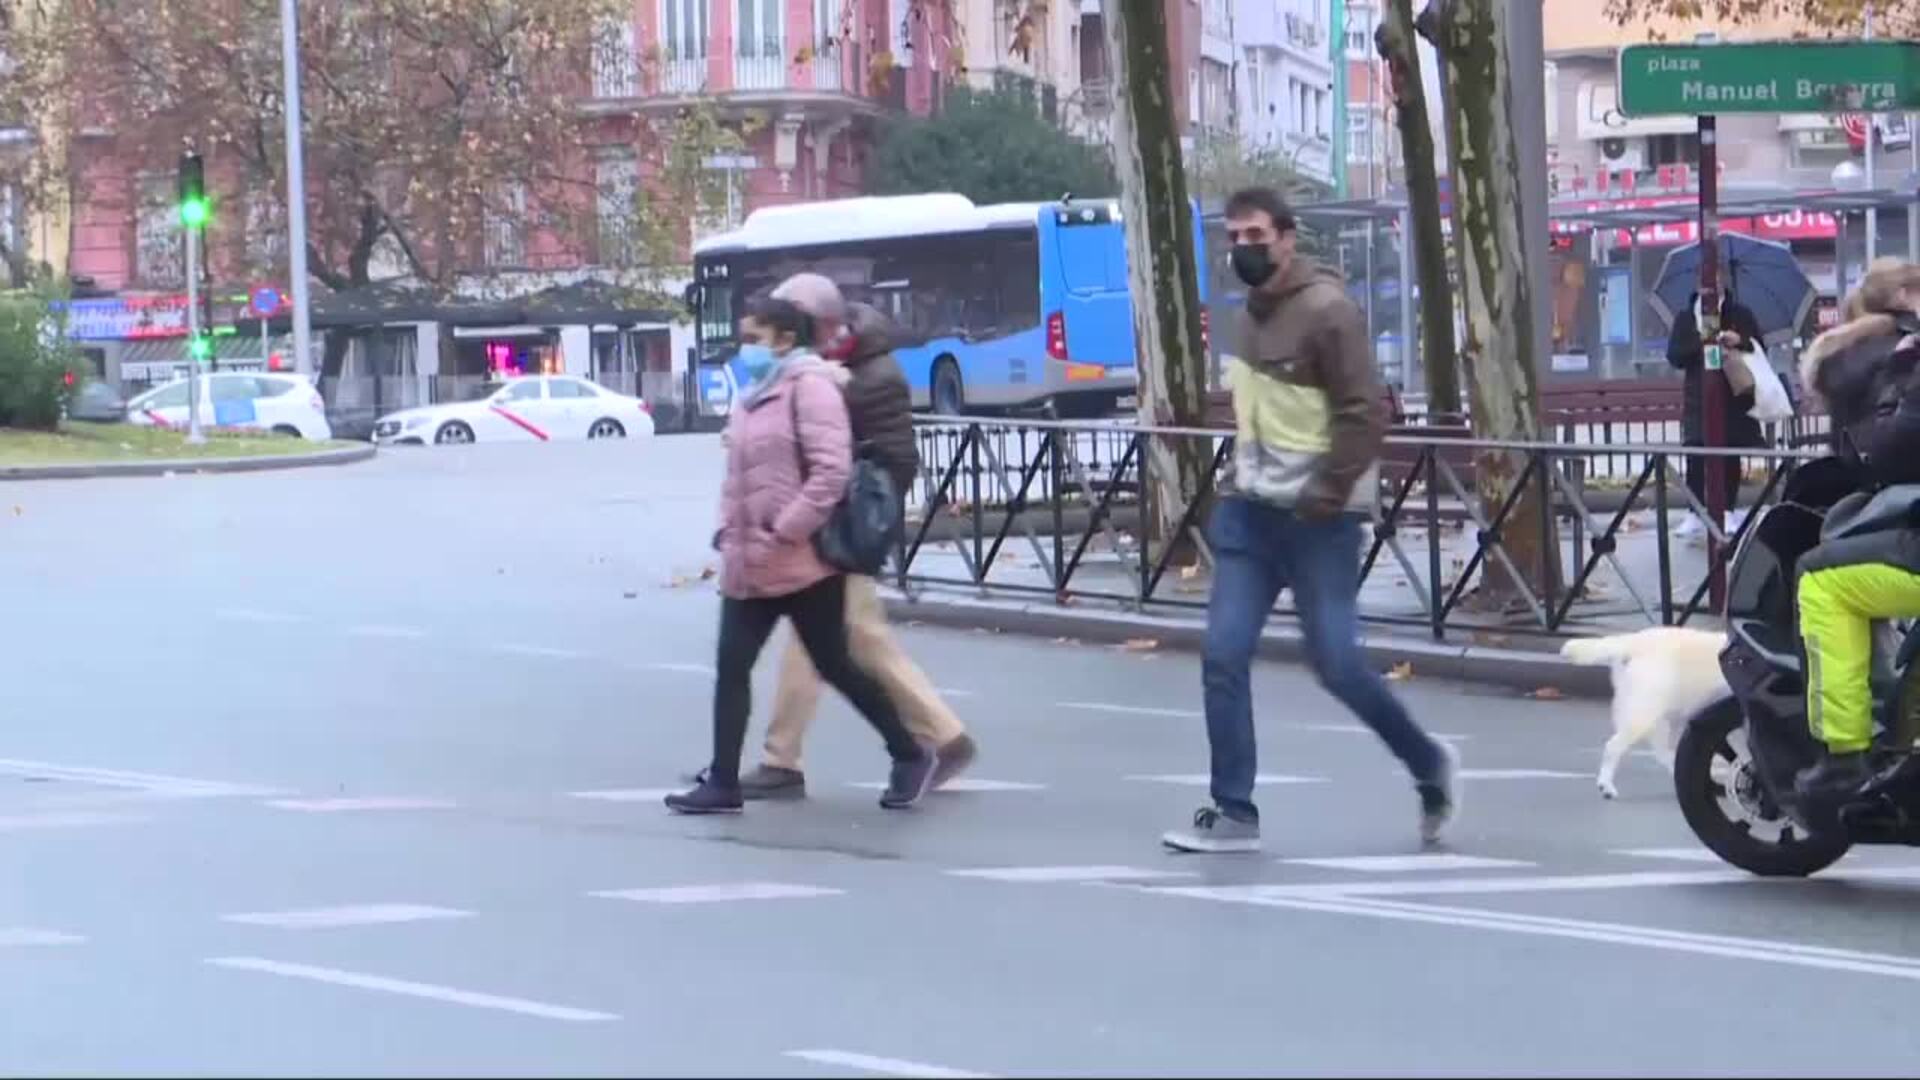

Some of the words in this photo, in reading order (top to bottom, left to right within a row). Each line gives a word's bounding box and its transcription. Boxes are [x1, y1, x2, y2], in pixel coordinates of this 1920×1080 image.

[1648, 55, 1701, 72] plaza
[1682, 80, 1778, 100] Manuel
[1796, 79, 1896, 98] Brra
